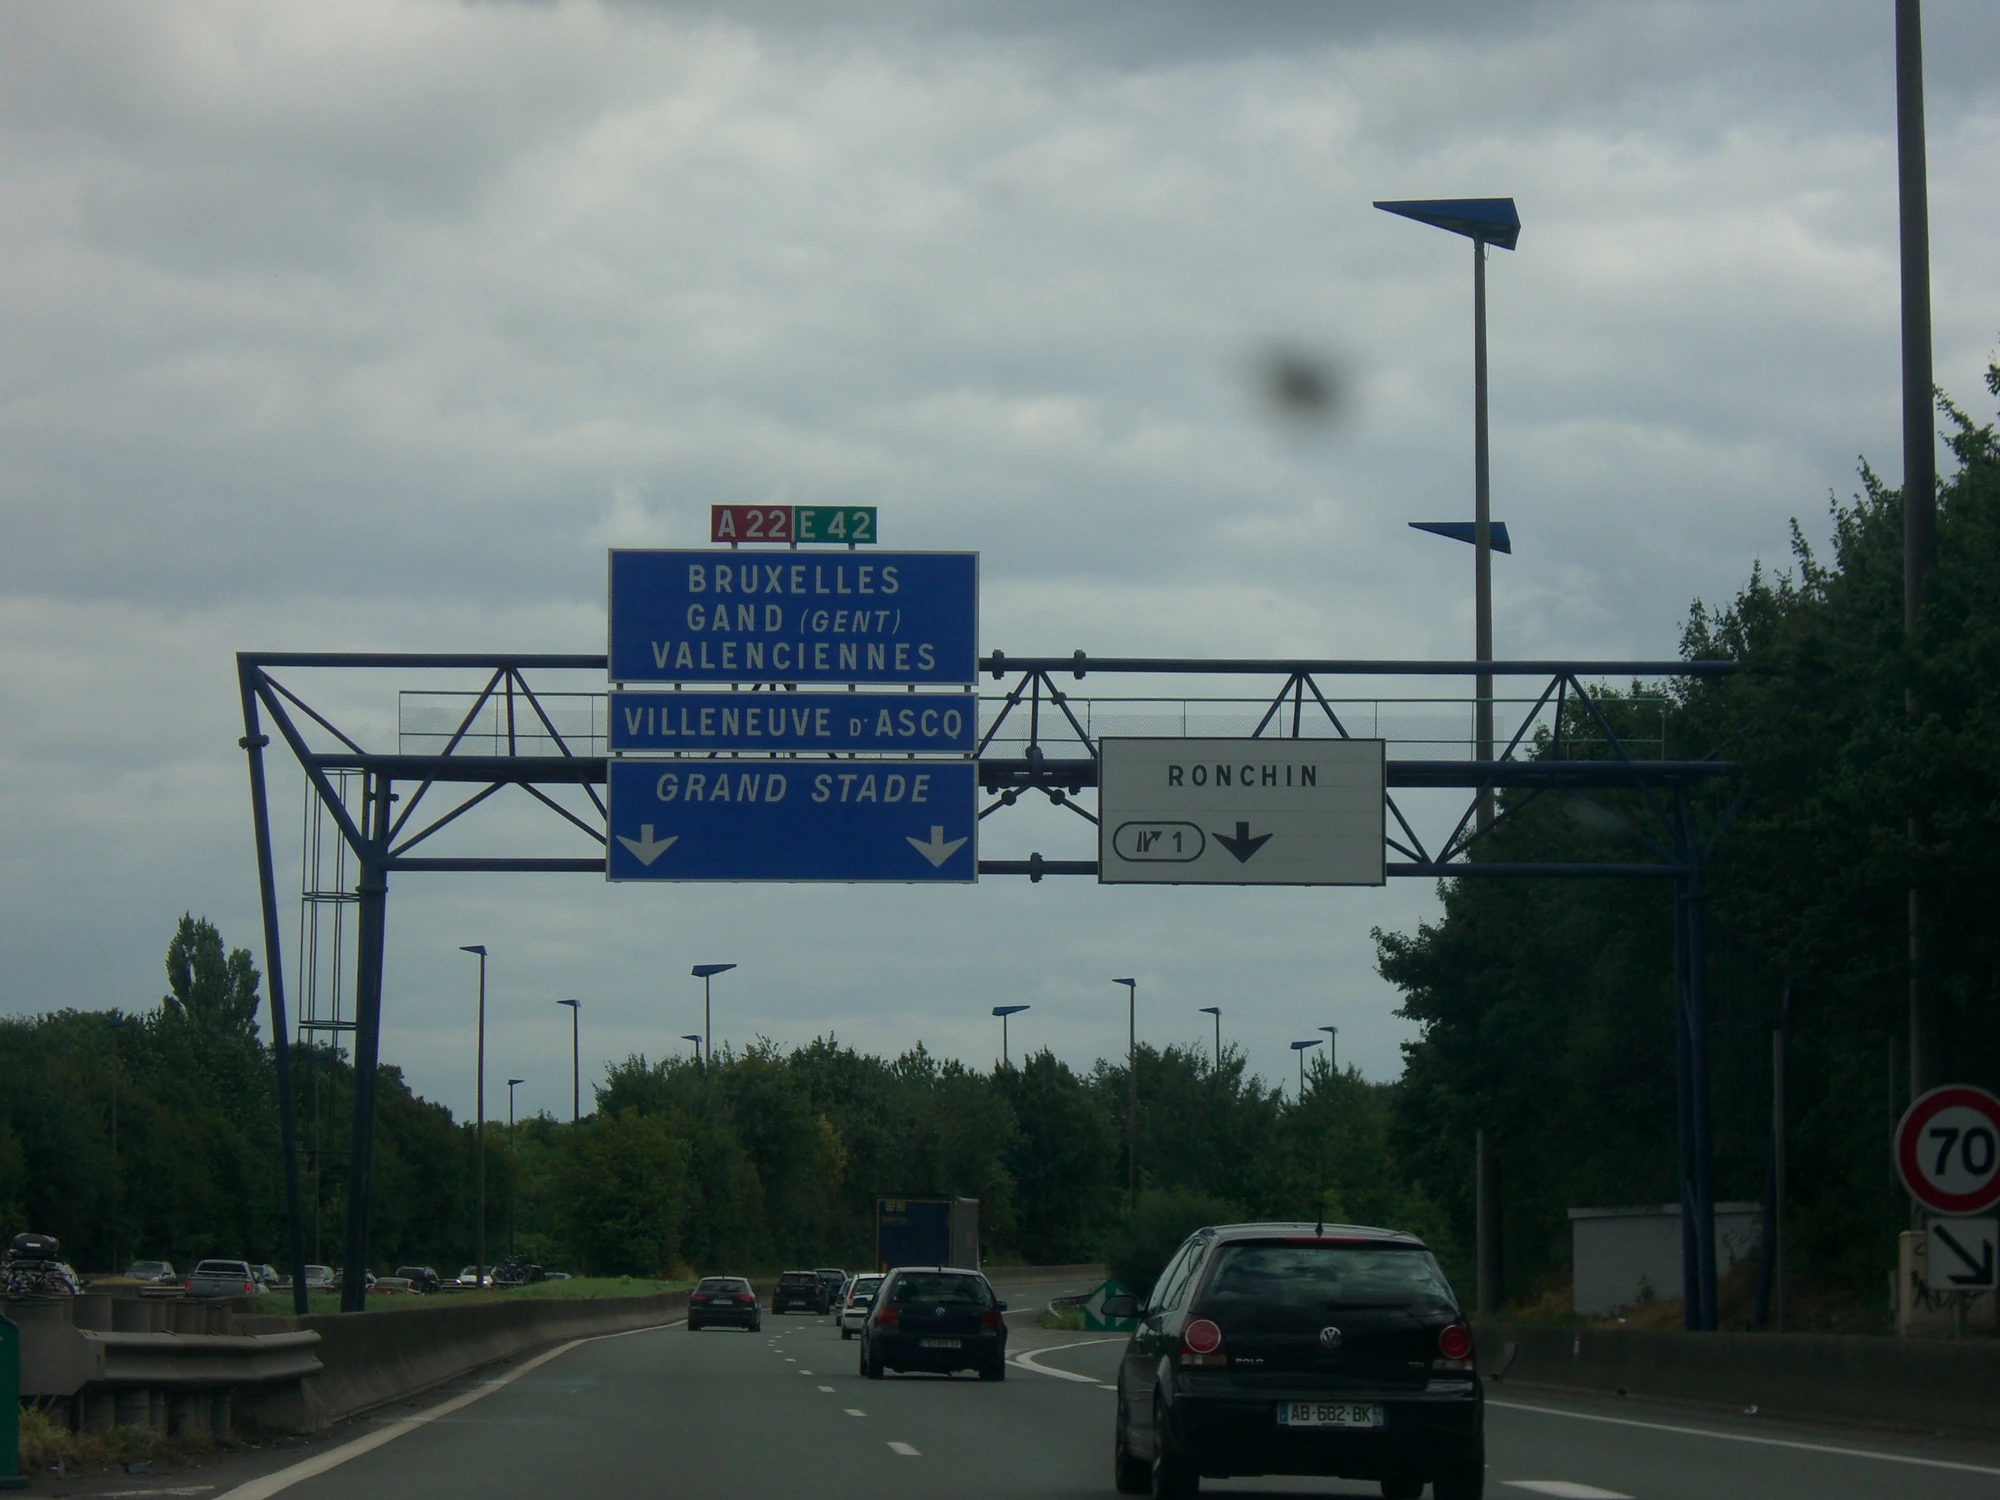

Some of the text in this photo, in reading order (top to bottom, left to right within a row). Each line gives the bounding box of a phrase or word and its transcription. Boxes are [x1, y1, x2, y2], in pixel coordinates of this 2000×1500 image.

[718, 510, 787, 538] A 22
[800, 511, 871, 539] E 42
[688, 565, 900, 594] BRUXELLES
[687, 604, 901, 635] GAND (GENT)
[651, 641, 936, 671] VALENCIENNES
[624, 707, 831, 737] VILLENEUVE
[656, 773, 931, 803] GRAND STADE
[1168, 764, 1317, 787] RONCHIN
[1172, 831, 1182, 853] 1
[1929, 1127, 1995, 1176] 70
[1291, 1404, 1371, 1423] AB-682-BK
